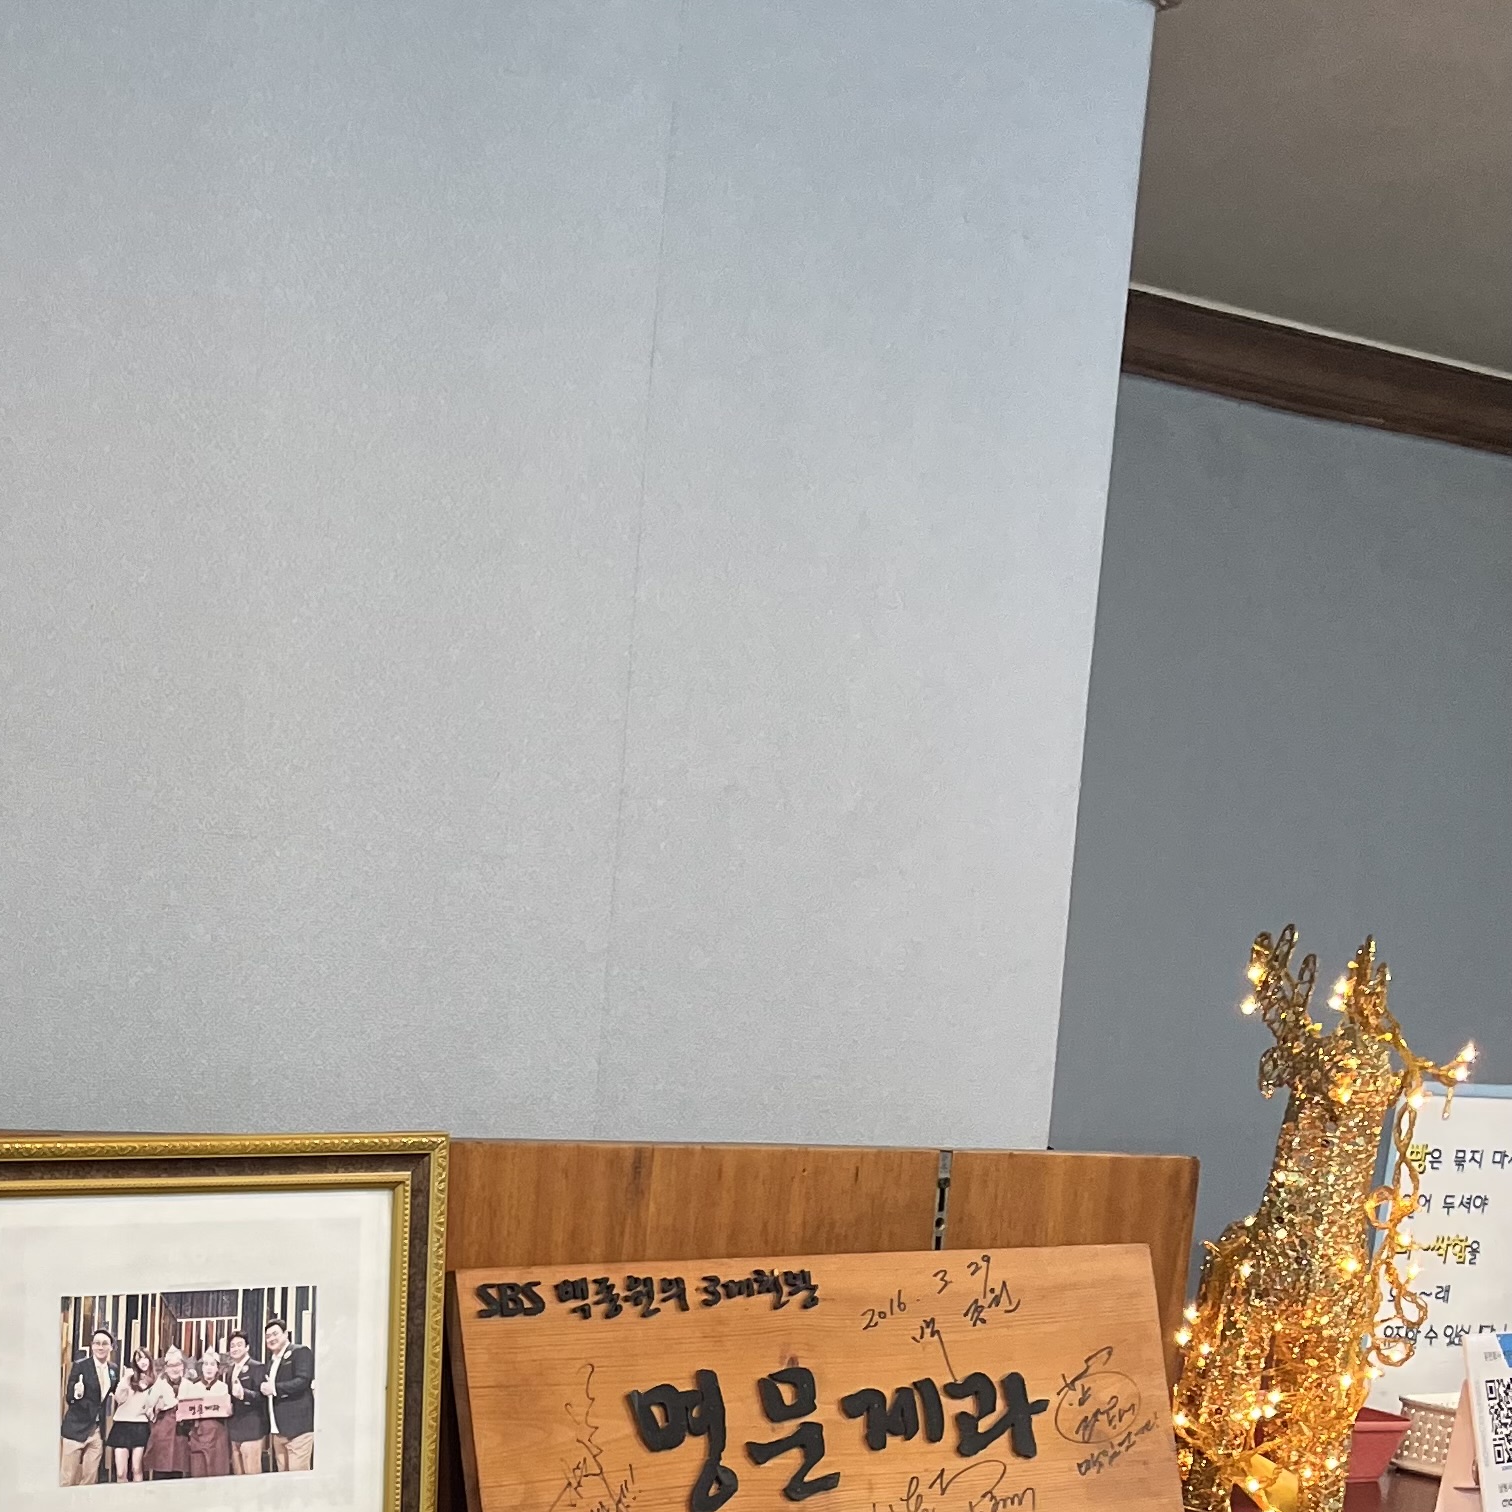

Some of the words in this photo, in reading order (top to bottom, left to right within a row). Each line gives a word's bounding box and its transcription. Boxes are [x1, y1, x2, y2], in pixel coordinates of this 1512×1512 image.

[1453, 1149, 1484, 1172] 묶지
[1492, 1149, 1512, 1170] 마
[1442, 1194, 1489, 1215] 두셔야
[476, 1281, 546, 1318] SBS
